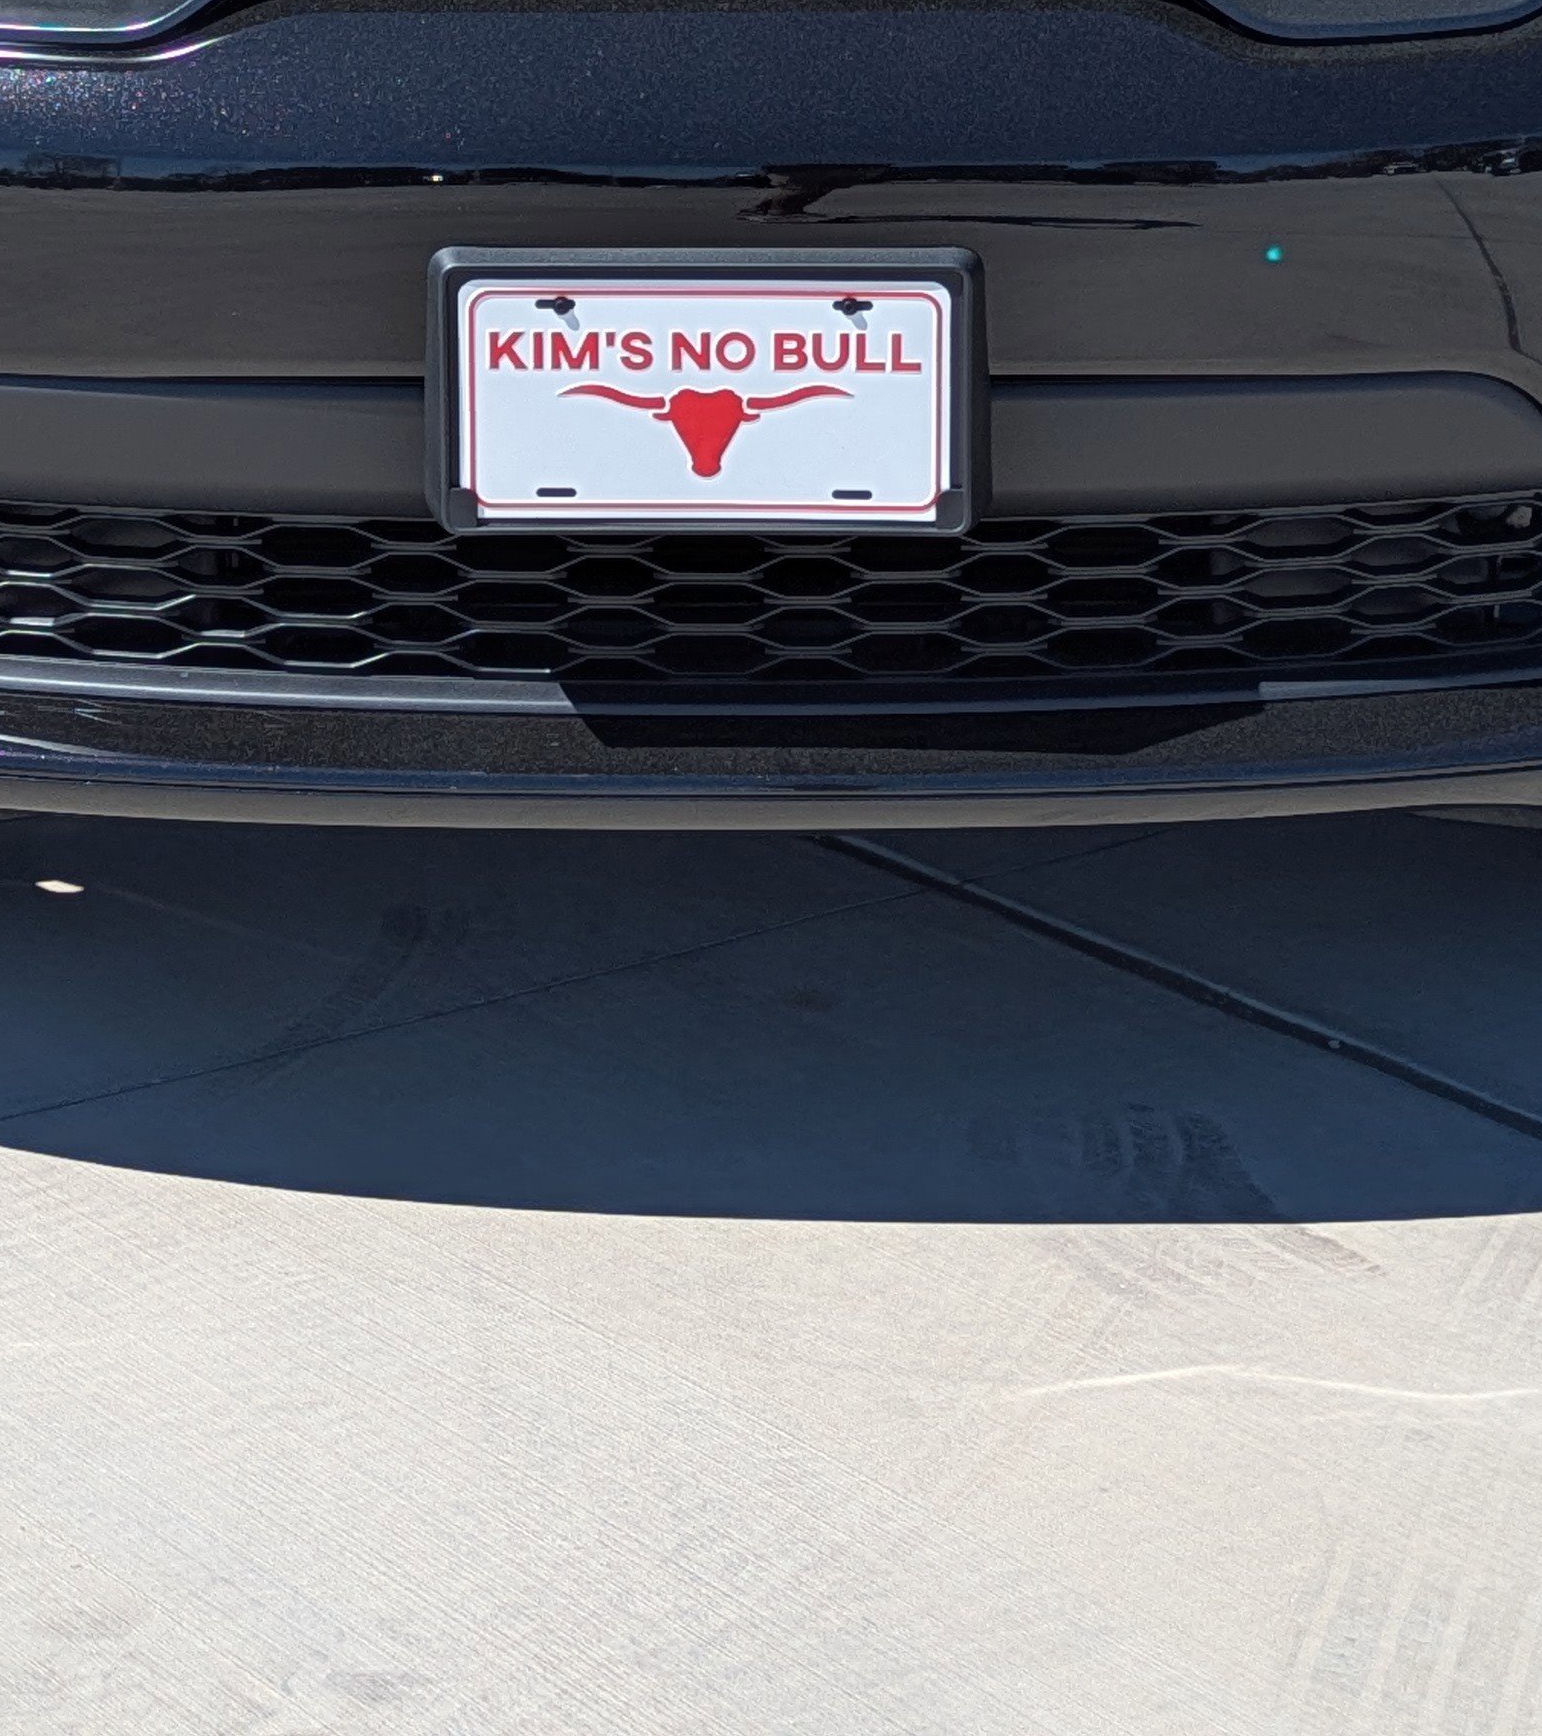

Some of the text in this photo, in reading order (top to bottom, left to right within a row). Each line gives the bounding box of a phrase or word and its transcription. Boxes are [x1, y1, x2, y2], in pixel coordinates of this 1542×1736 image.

[488, 331, 922, 374] KIM'S NO BULL
